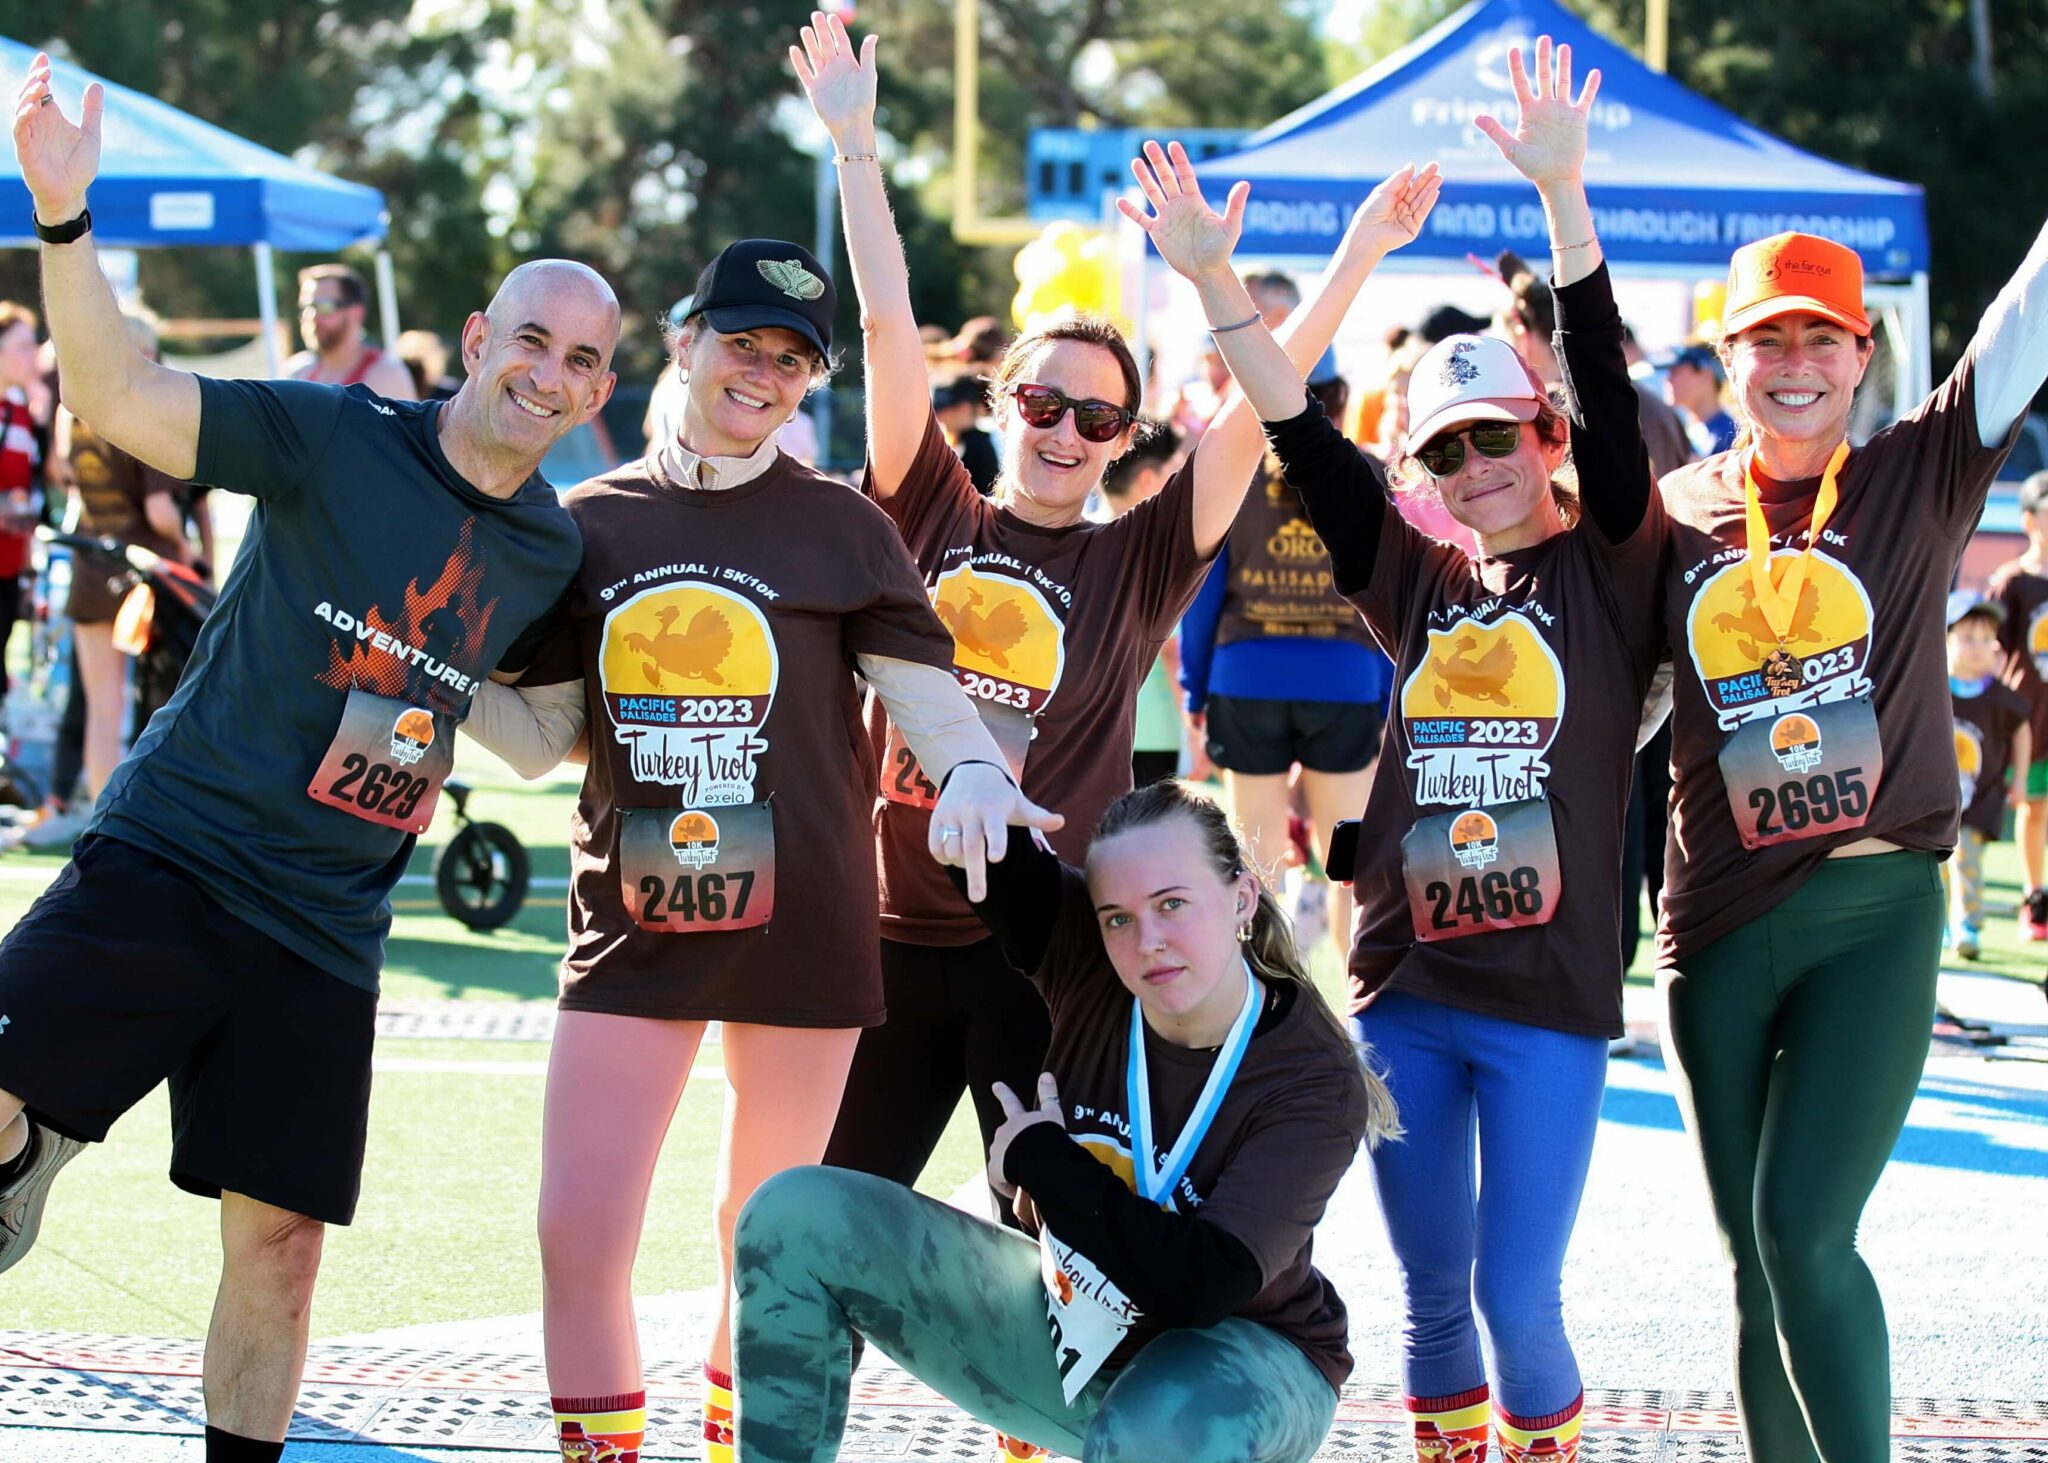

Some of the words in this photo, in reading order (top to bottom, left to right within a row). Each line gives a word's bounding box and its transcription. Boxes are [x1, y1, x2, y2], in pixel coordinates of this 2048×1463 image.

[1431, 202, 1496, 239] AND
[1589, 206, 1718, 244] THROUGH
[1266, 536, 1328, 558] ORO
[600, 578, 628, 601] 9TH
[633, 563, 709, 584] ANNUAL
[722, 568, 780, 601] 5K/10K
[314, 601, 471, 693] ADVENTURE
[1717, 673, 1763, 695] PACIF
[1799, 646, 1855, 686] 023
[963, 672, 1031, 709] 2023
[1771, 686, 1792, 697] Trot
[619, 697, 676, 713] PACIFIC
[680, 699, 753, 723] 2023
[620, 711, 677, 722] PALISADES
[406, 736, 420, 748] 10K
[1413, 721, 1466, 734] PACIFIC
[1468, 720, 1539, 744] 2023
[1414, 733, 1465, 744] PALISADES
[1789, 743, 1807, 753] 10K
[619, 729, 702, 806] Turkey
[690, 732, 764, 781] Trot
[1411, 753, 1487, 806] Turkey
[1476, 753, 1546, 800] Trot
[328, 752, 429, 820] 2629
[704, 791, 745, 804] exela
[705, 783, 735, 792] POWERED
[1749, 766, 1868, 837] 2695
[686, 841, 703, 849] 10K
[1466, 840, 1483, 850] 10K
[640, 870, 755, 923] 2467
[1425, 866, 1543, 930] 2468
